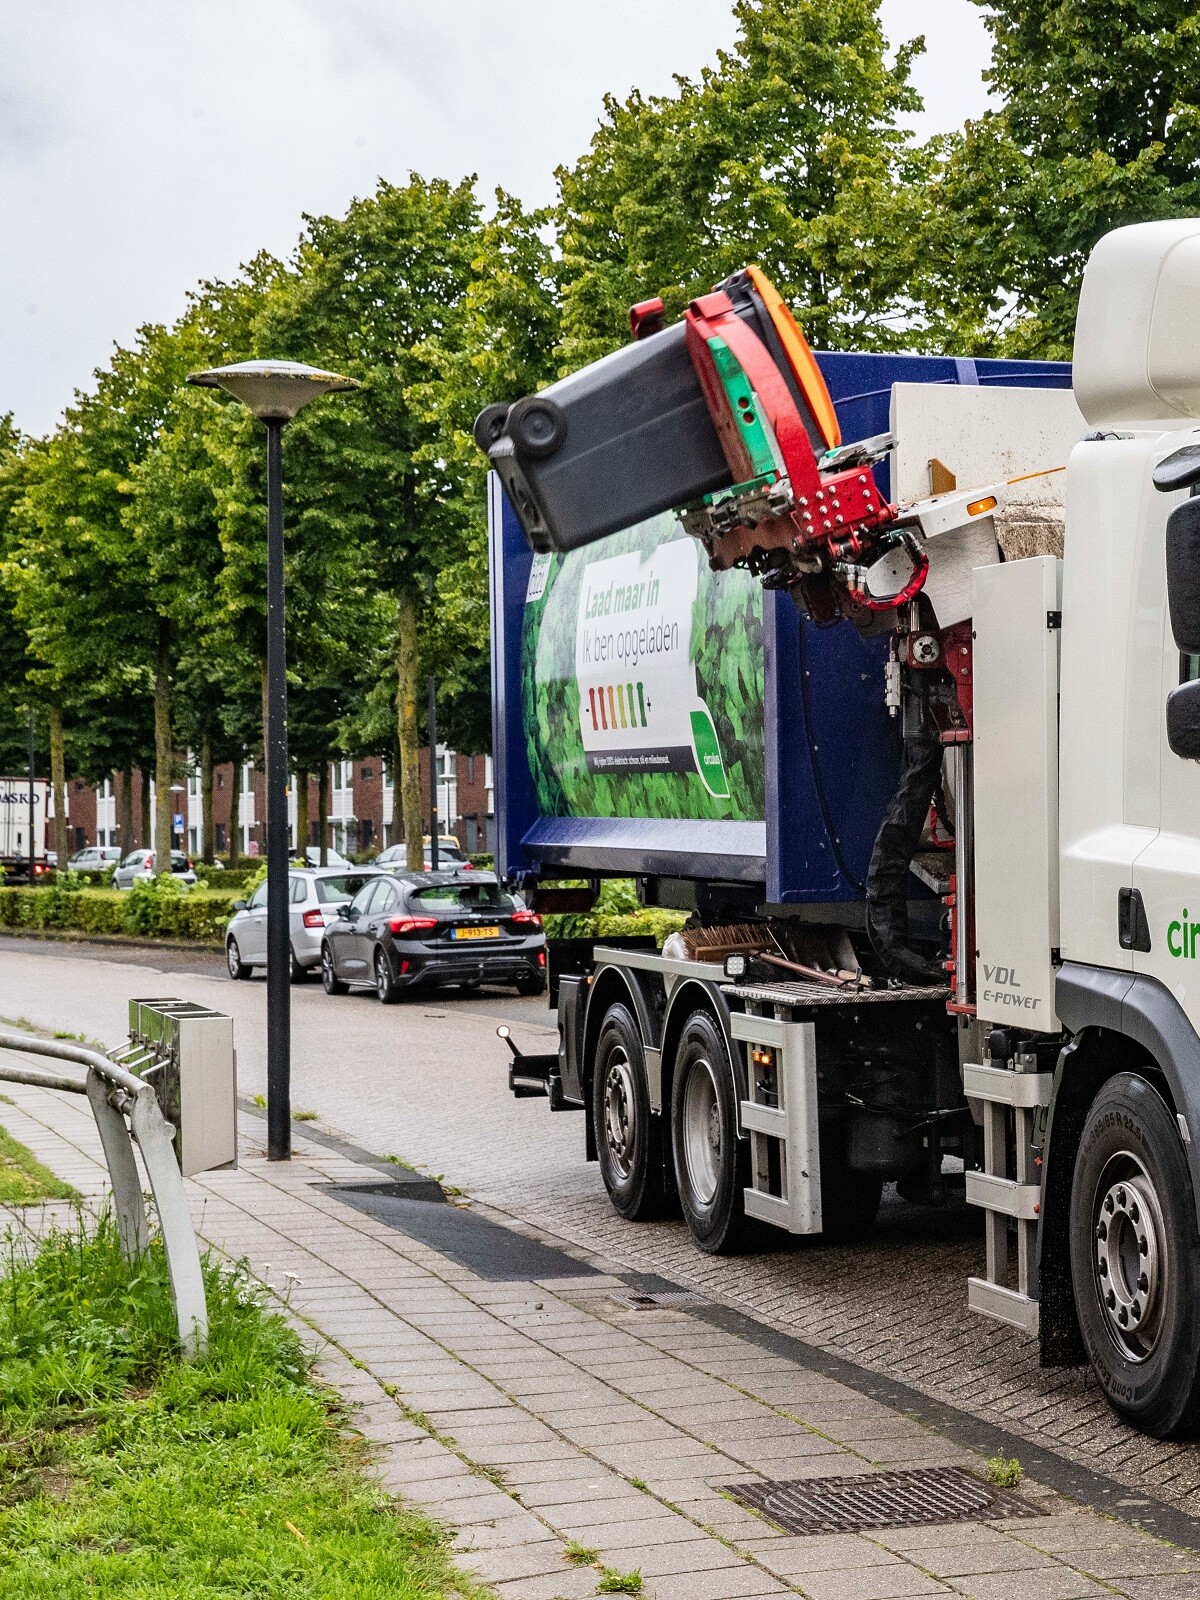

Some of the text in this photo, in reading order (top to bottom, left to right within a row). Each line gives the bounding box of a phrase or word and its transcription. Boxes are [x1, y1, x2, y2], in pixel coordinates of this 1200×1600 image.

[585, 571, 660, 619] Laad maar in
[583, 615, 679, 667] Ik ben opgeladen
[0, 793, 40, 804] ASKO
[983, 964, 1021, 987] VDL
[1123, 1114, 1141, 1141] 22.5
[1110, 1379, 1133, 1402] Conti
